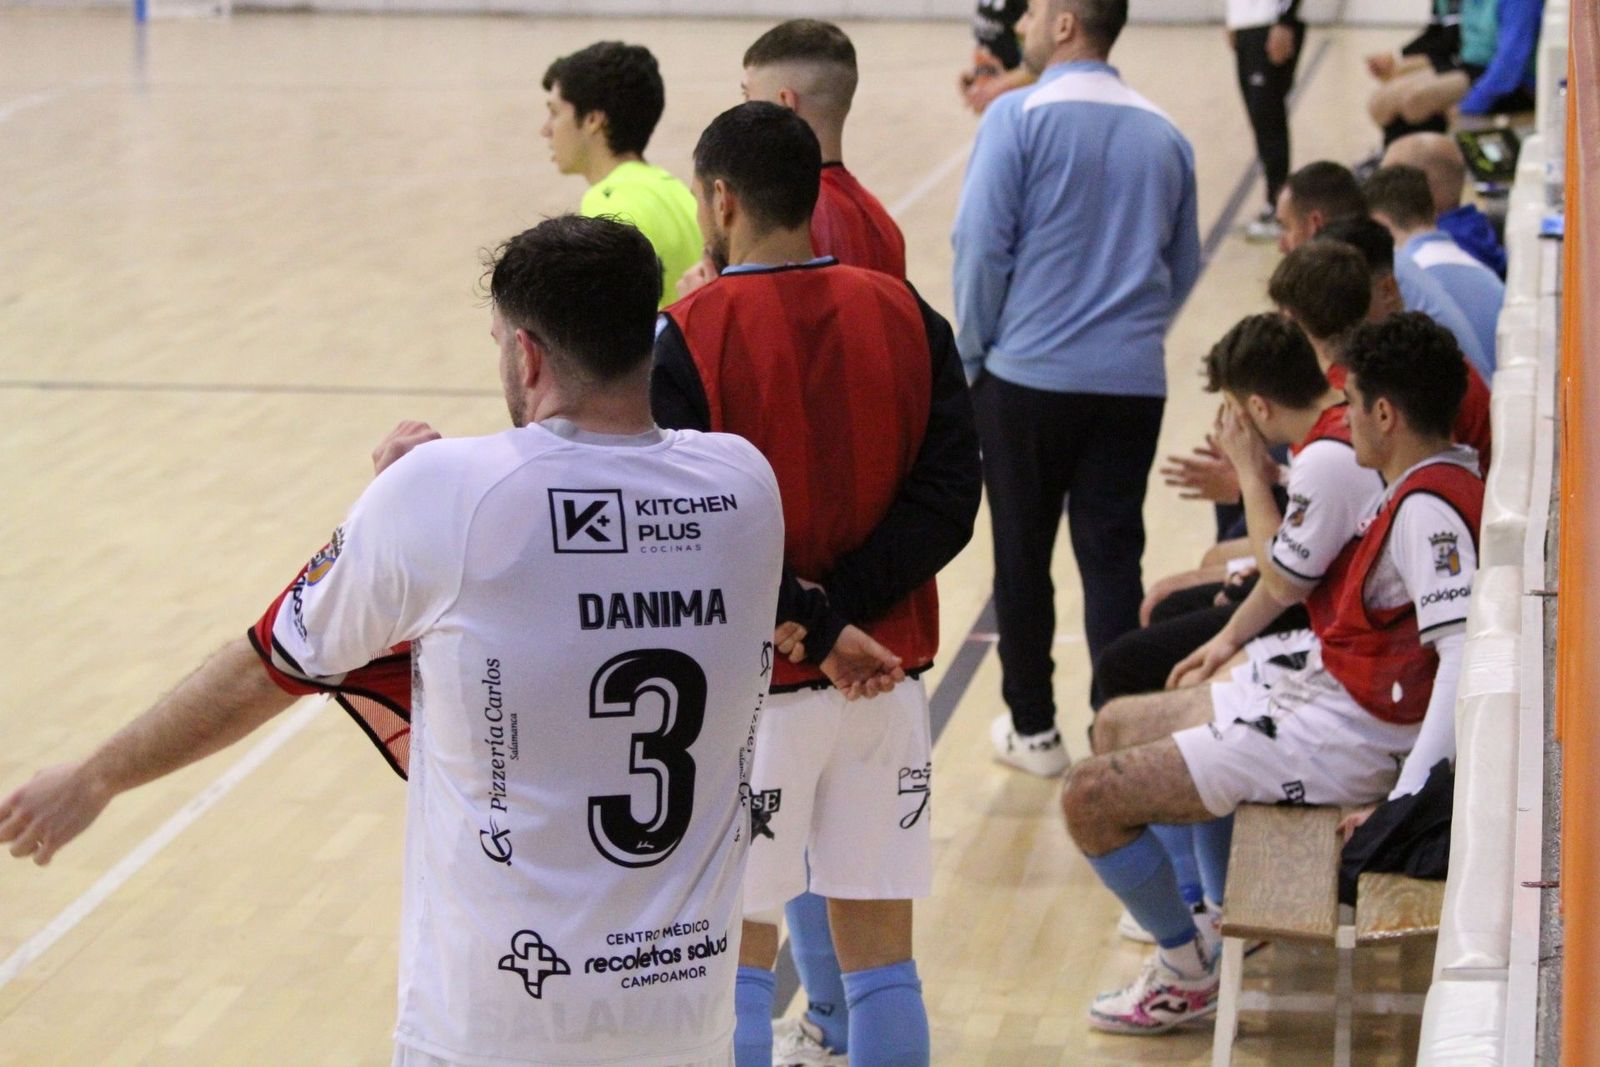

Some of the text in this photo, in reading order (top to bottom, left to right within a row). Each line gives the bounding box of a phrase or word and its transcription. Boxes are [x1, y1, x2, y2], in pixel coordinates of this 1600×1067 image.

[635, 494, 738, 516] KITCHEN
[638, 522, 701, 541] PLUS
[640, 544, 702, 553] COCINAS
[578, 588, 727, 630] DANIMA
[481, 658, 507, 812] Pizzería Carlos
[509, 713, 519, 760] Salamanca
[588, 648, 707, 868] 3
[606, 919, 710, 945] CENTRO MÉDICO
[584, 930, 728, 974] recoletas salud
[620, 966, 707, 989] CAMPOAMOR
